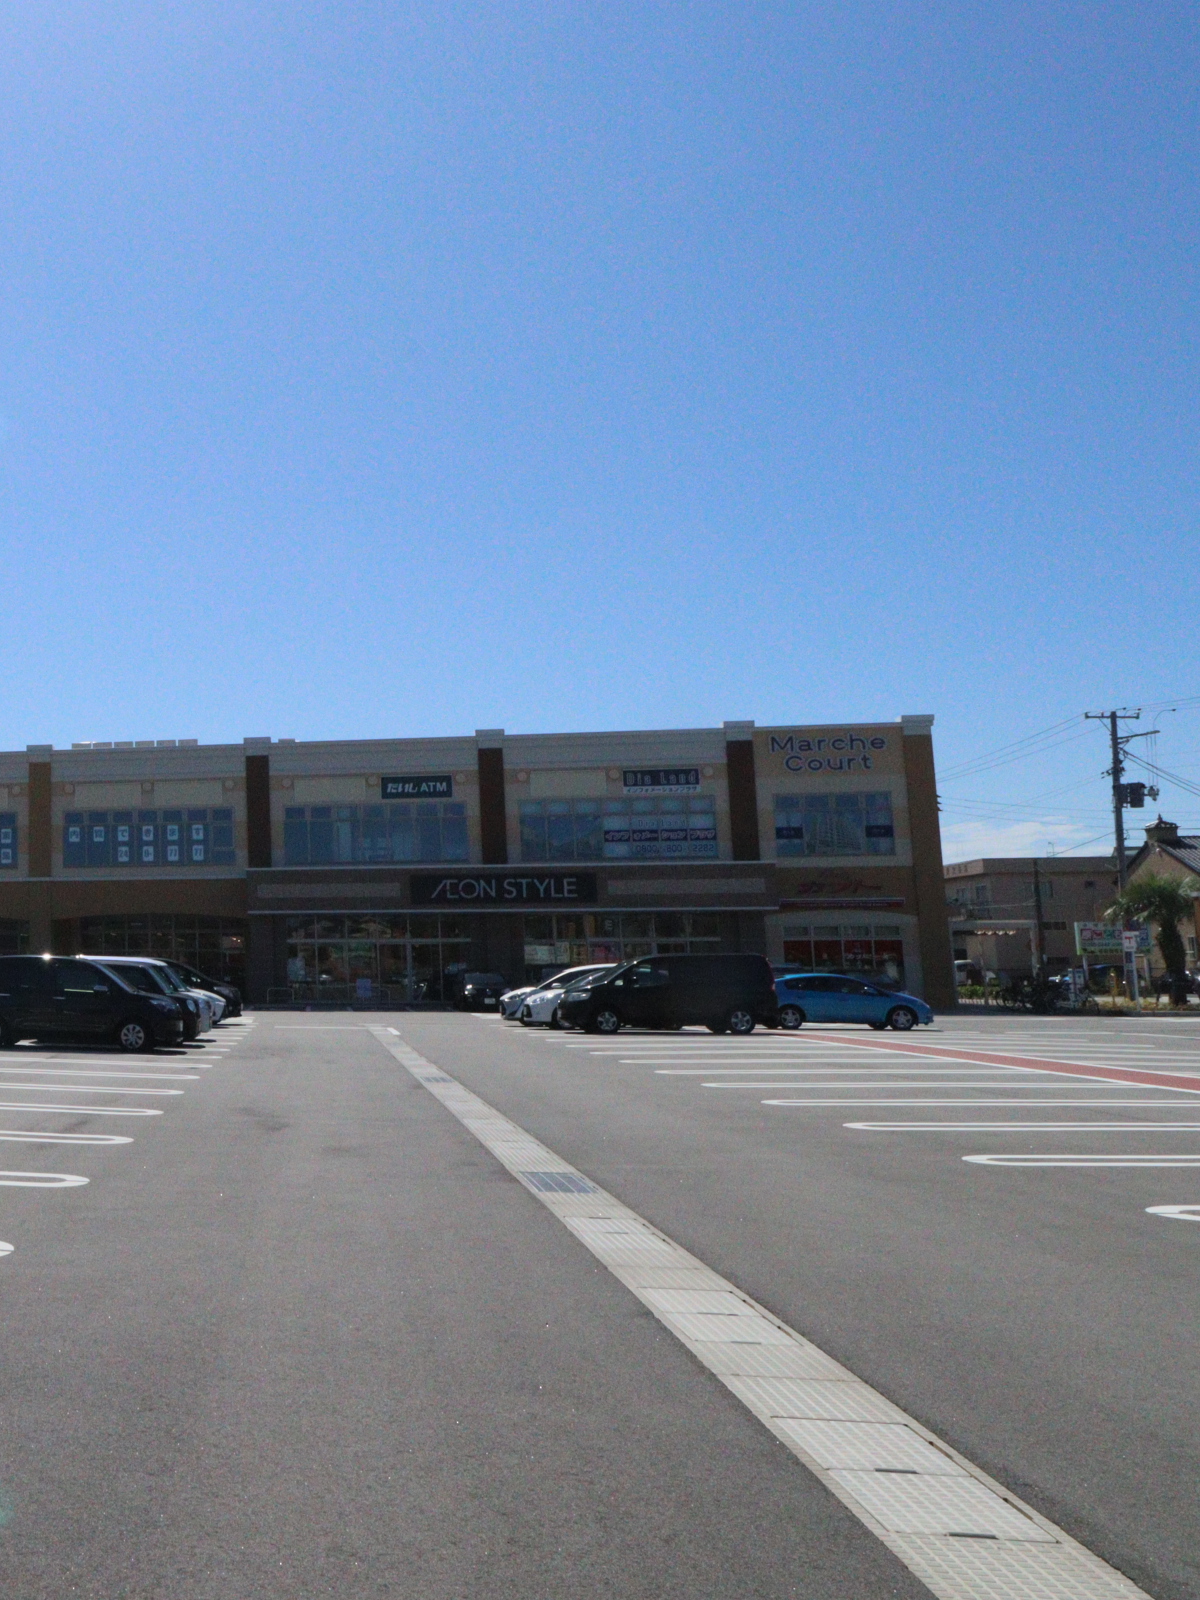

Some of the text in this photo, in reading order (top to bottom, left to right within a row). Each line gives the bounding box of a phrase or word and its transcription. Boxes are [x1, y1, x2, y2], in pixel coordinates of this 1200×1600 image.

[770, 733, 886, 753] Marche
[785, 754, 871, 772] Court
[420, 781, 447, 792] ATM
[660, 770, 697, 785] Land
[503, 877, 578, 899] STYLE
